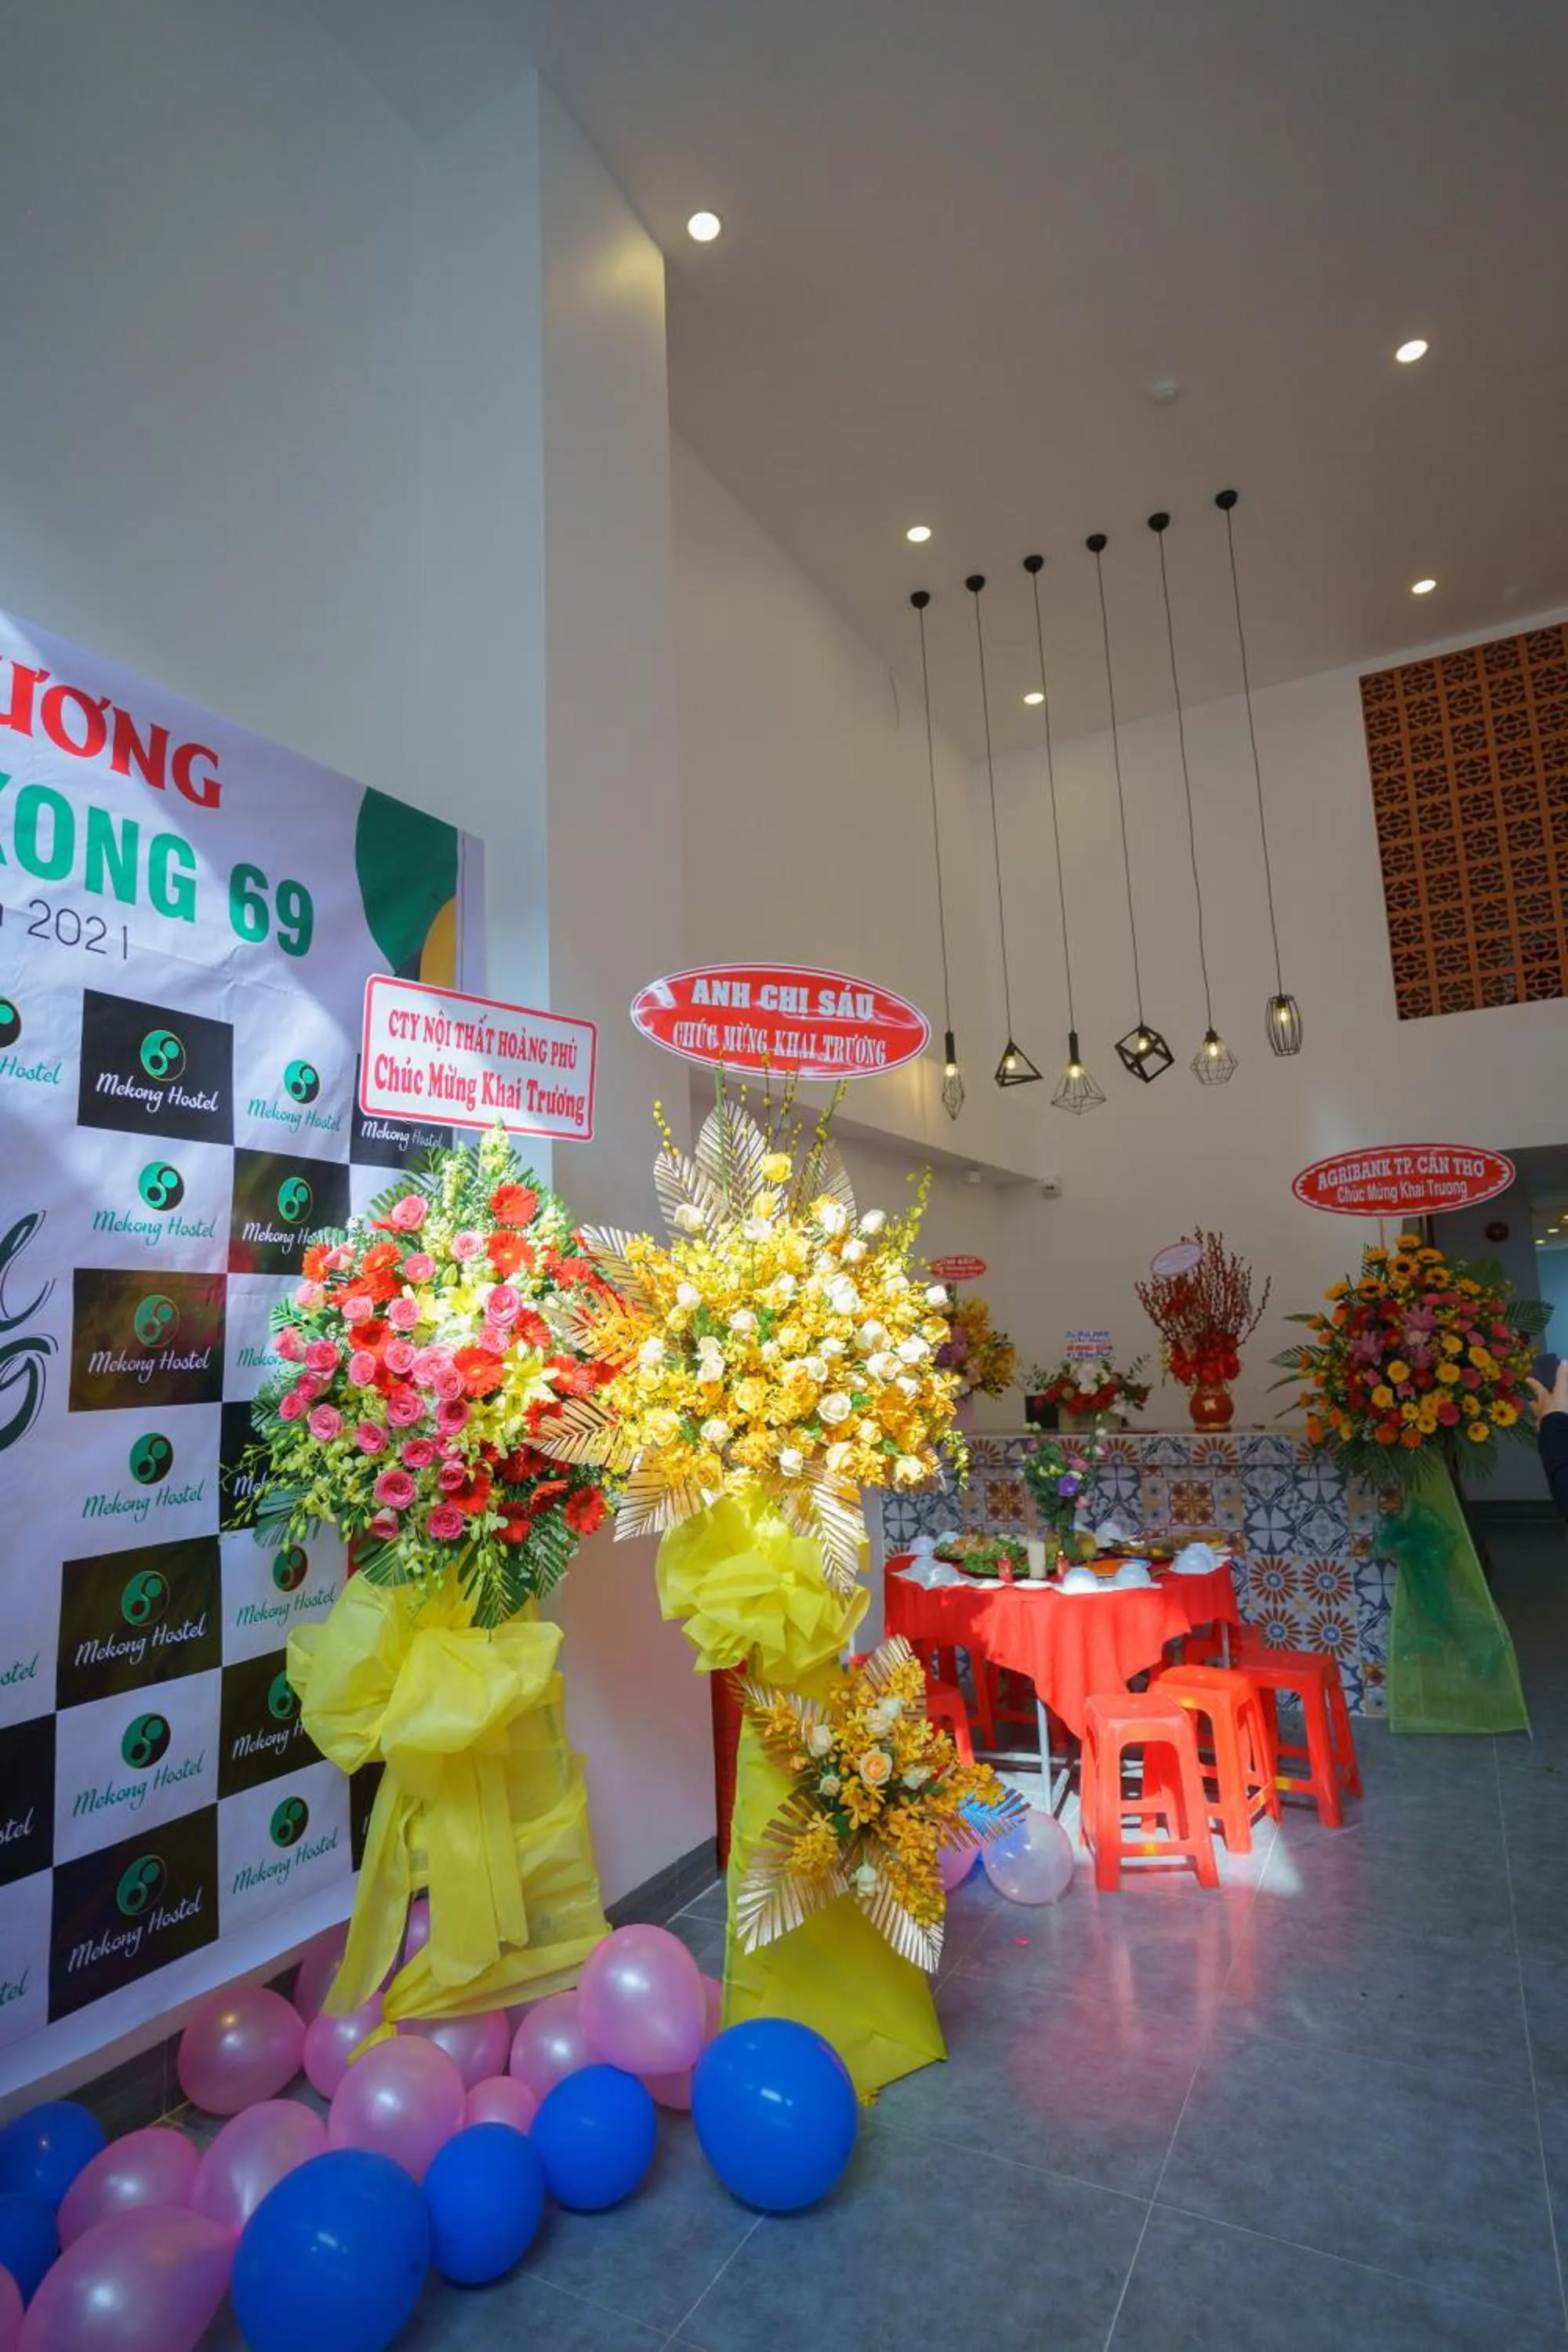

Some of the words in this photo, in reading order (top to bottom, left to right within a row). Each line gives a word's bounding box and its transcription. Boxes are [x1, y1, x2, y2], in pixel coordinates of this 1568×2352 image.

[27, 898, 129, 960] 2021
[229, 863, 314, 957] 69
[691, 978, 751, 1009] ANH
[818, 984, 875, 1020] SÁU
[388, 1009, 421, 1041] CTY
[423, 1010, 452, 1052] NỘI
[455, 1014, 495, 1054] THẤT
[497, 1026, 548, 1064] HOÀNG
[722, 1020, 768, 1054] MỪNG
[774, 1029, 818, 1059] KHAI
[0, 1055, 62, 1085] Hostel
[374, 1054, 424, 1094] Chúc
[427, 1062, 477, 1112] Mừng
[481, 1071, 521, 1109] Khai
[526, 1078, 585, 1127] Trương
[96, 1072, 164, 1113] Mekong
[167, 1085, 219, 1112] Hostel
[247, 1098, 303, 1134] Mekong
[305, 1110, 343, 1133] Hostel
[361, 1120, 411, 1151] Mekong
[412, 1128, 443, 1149] Hostel
[1317, 1159, 1392, 1191] AGRIBANK
[1394, 1156, 1414, 1174] TP.
[1337, 1183, 1365, 1203] Chúc
[1399, 1180, 1425, 1199] Khai
[93, 1210, 162, 1246] Mekong
[167, 1217, 216, 1238] Hostel
[241, 1222, 294, 1254] Mekong
[88, 1348, 155, 1384] Mekong
[159, 1346, 211, 1370] Hostel
[82, 1491, 151, 1523] Mekong
[156, 1479, 205, 1507] Hostel
[236, 1599, 290, 1628] Mekong
[293, 1582, 336, 1613] Hostel
[74, 1633, 147, 1666] Mekong
[152, 1611, 206, 1648] Hostel
[231, 1728, 289, 1760] Mekong
[72, 1780, 147, 1818] Mekong
[154, 1749, 206, 1790] Hostel
[233, 1857, 291, 1894] Mekong
[296, 1828, 338, 1866] Hostel
[67, 1925, 143, 1973] Mekong
[147, 1885, 204, 1934] Hostel
